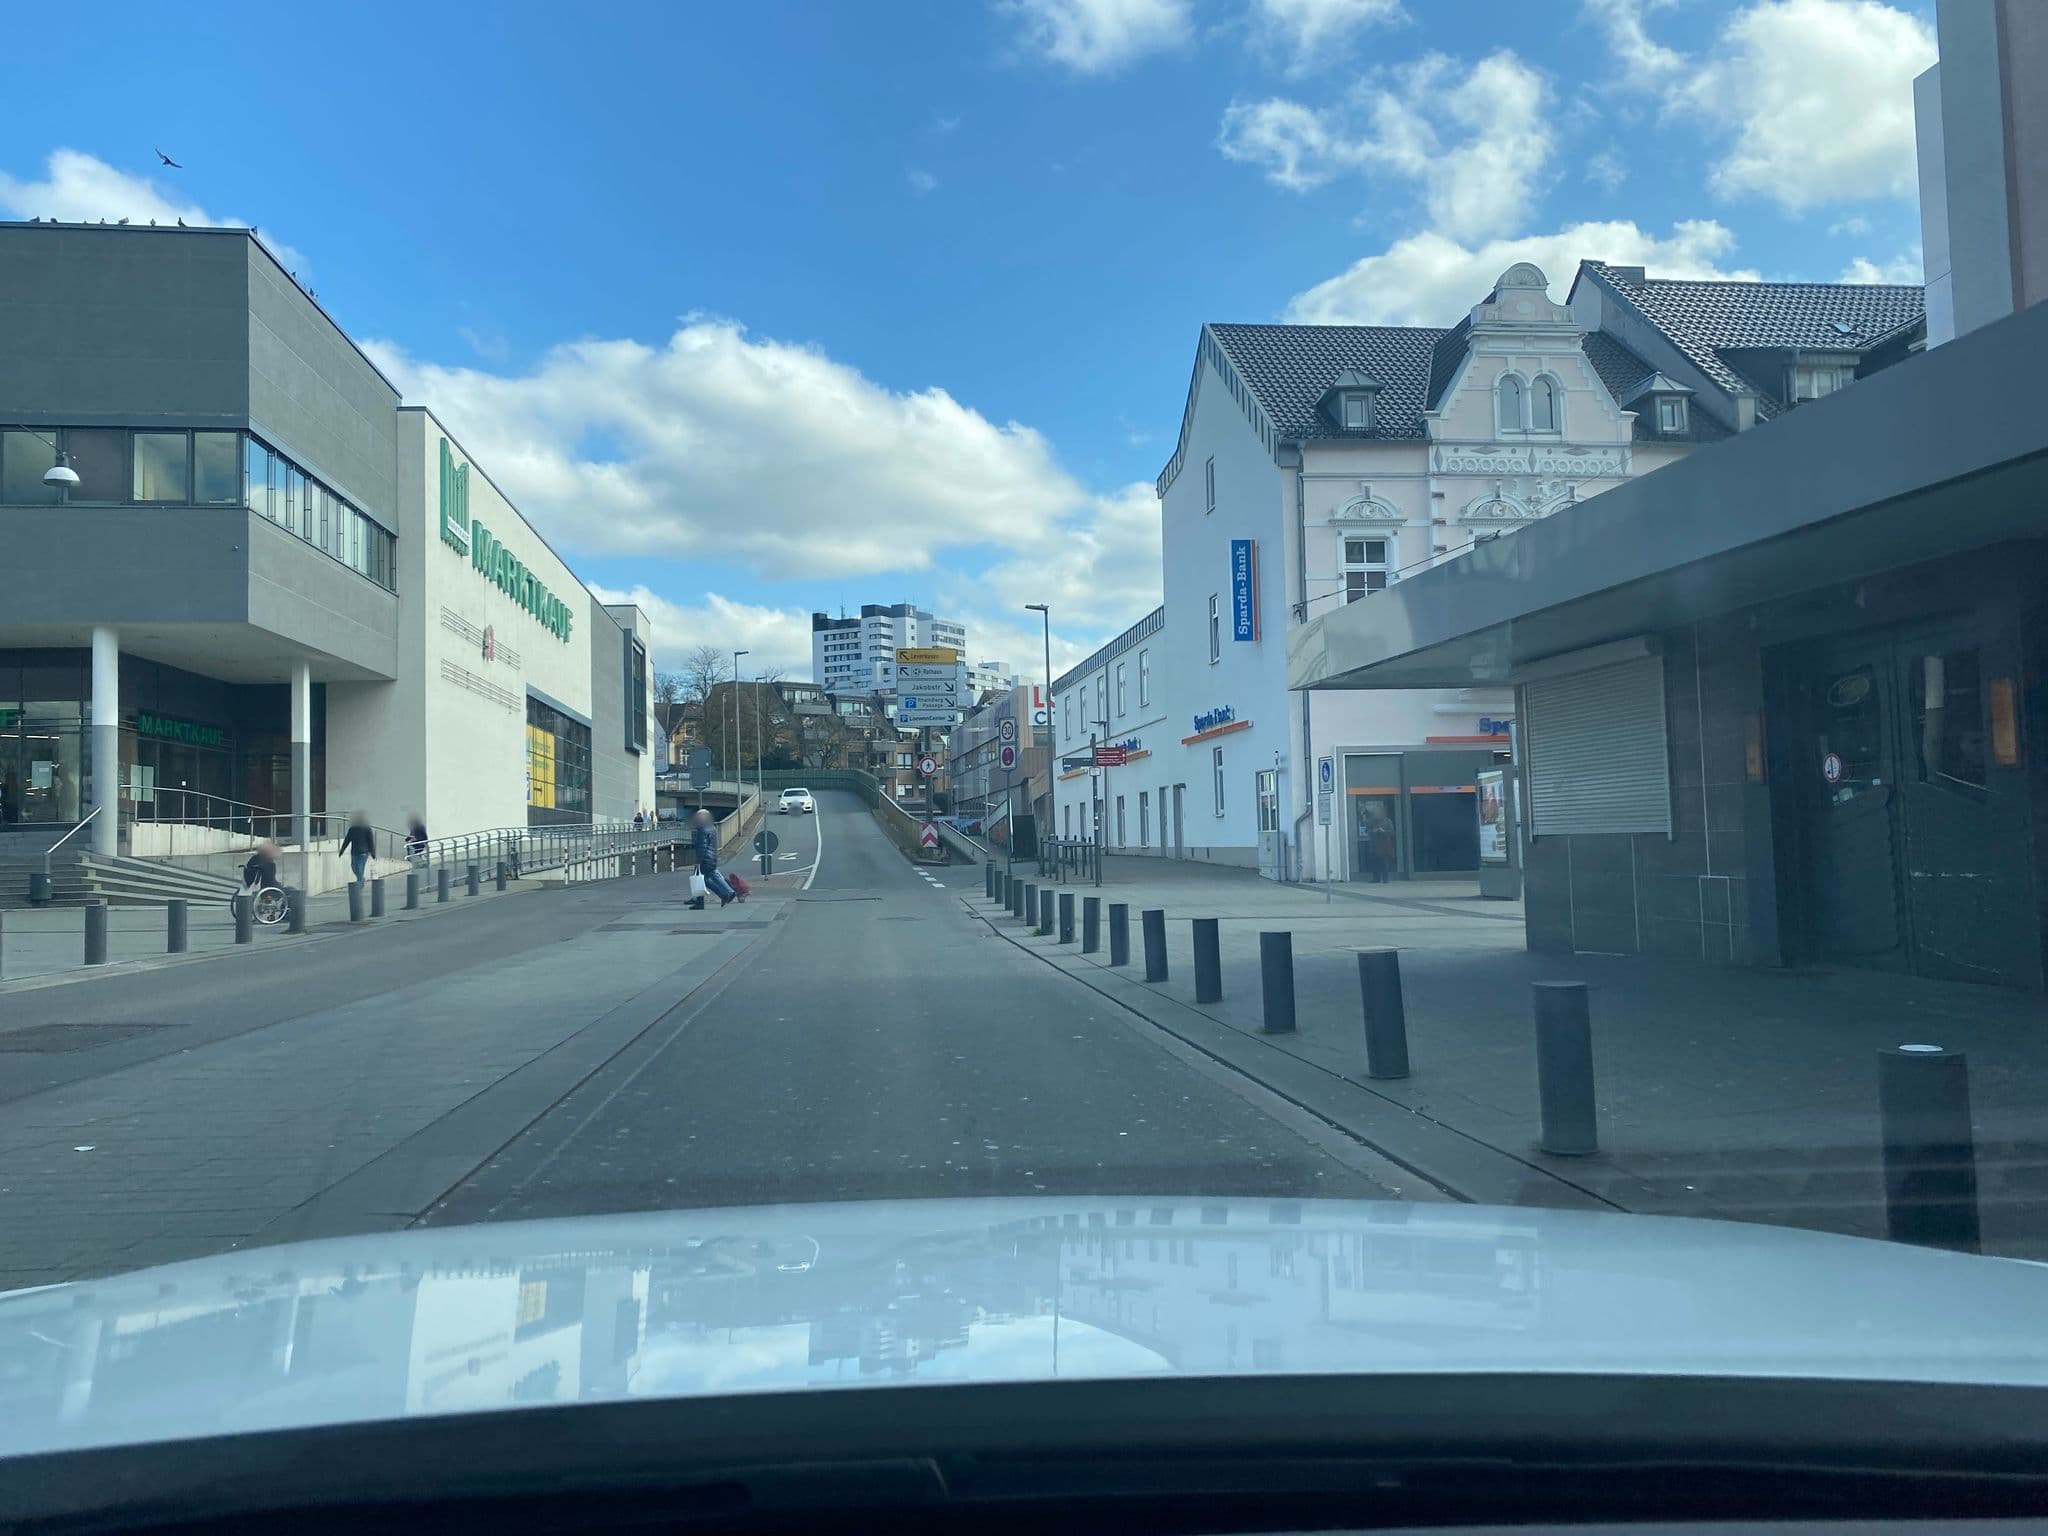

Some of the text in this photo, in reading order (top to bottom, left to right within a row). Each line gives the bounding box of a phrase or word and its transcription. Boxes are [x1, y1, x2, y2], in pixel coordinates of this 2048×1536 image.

[472, 519, 573, 643] MARKTKAUF
[1236, 545, 1250, 635] Sparda-Bank
[139, 712, 224, 745] MARKTKAUF
